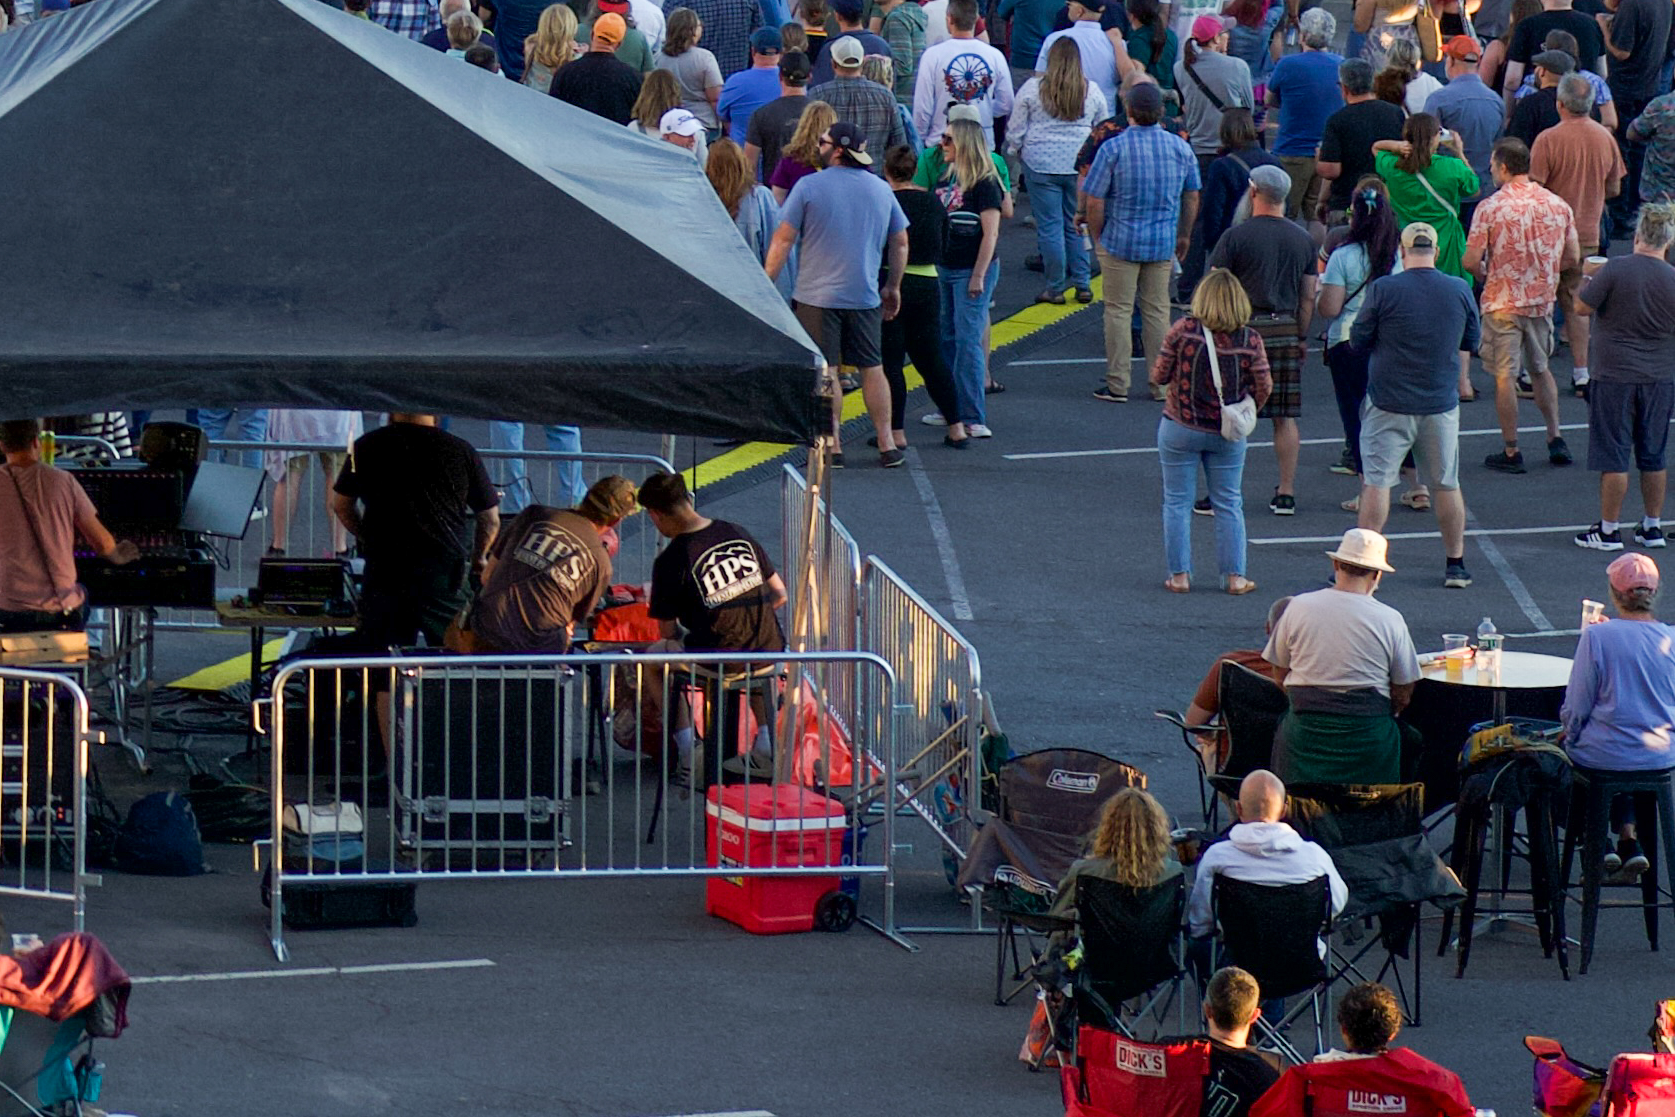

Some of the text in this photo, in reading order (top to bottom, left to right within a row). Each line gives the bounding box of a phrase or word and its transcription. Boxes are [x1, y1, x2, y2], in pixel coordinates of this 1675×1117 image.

[523, 531, 582, 581] HPS
[701, 552, 759, 596] HPS
[1052, 772, 1088, 788] Coleman
[1118, 1046, 1163, 1072] DICK'S
[1351, 1091, 1404, 1105] DICK'S
